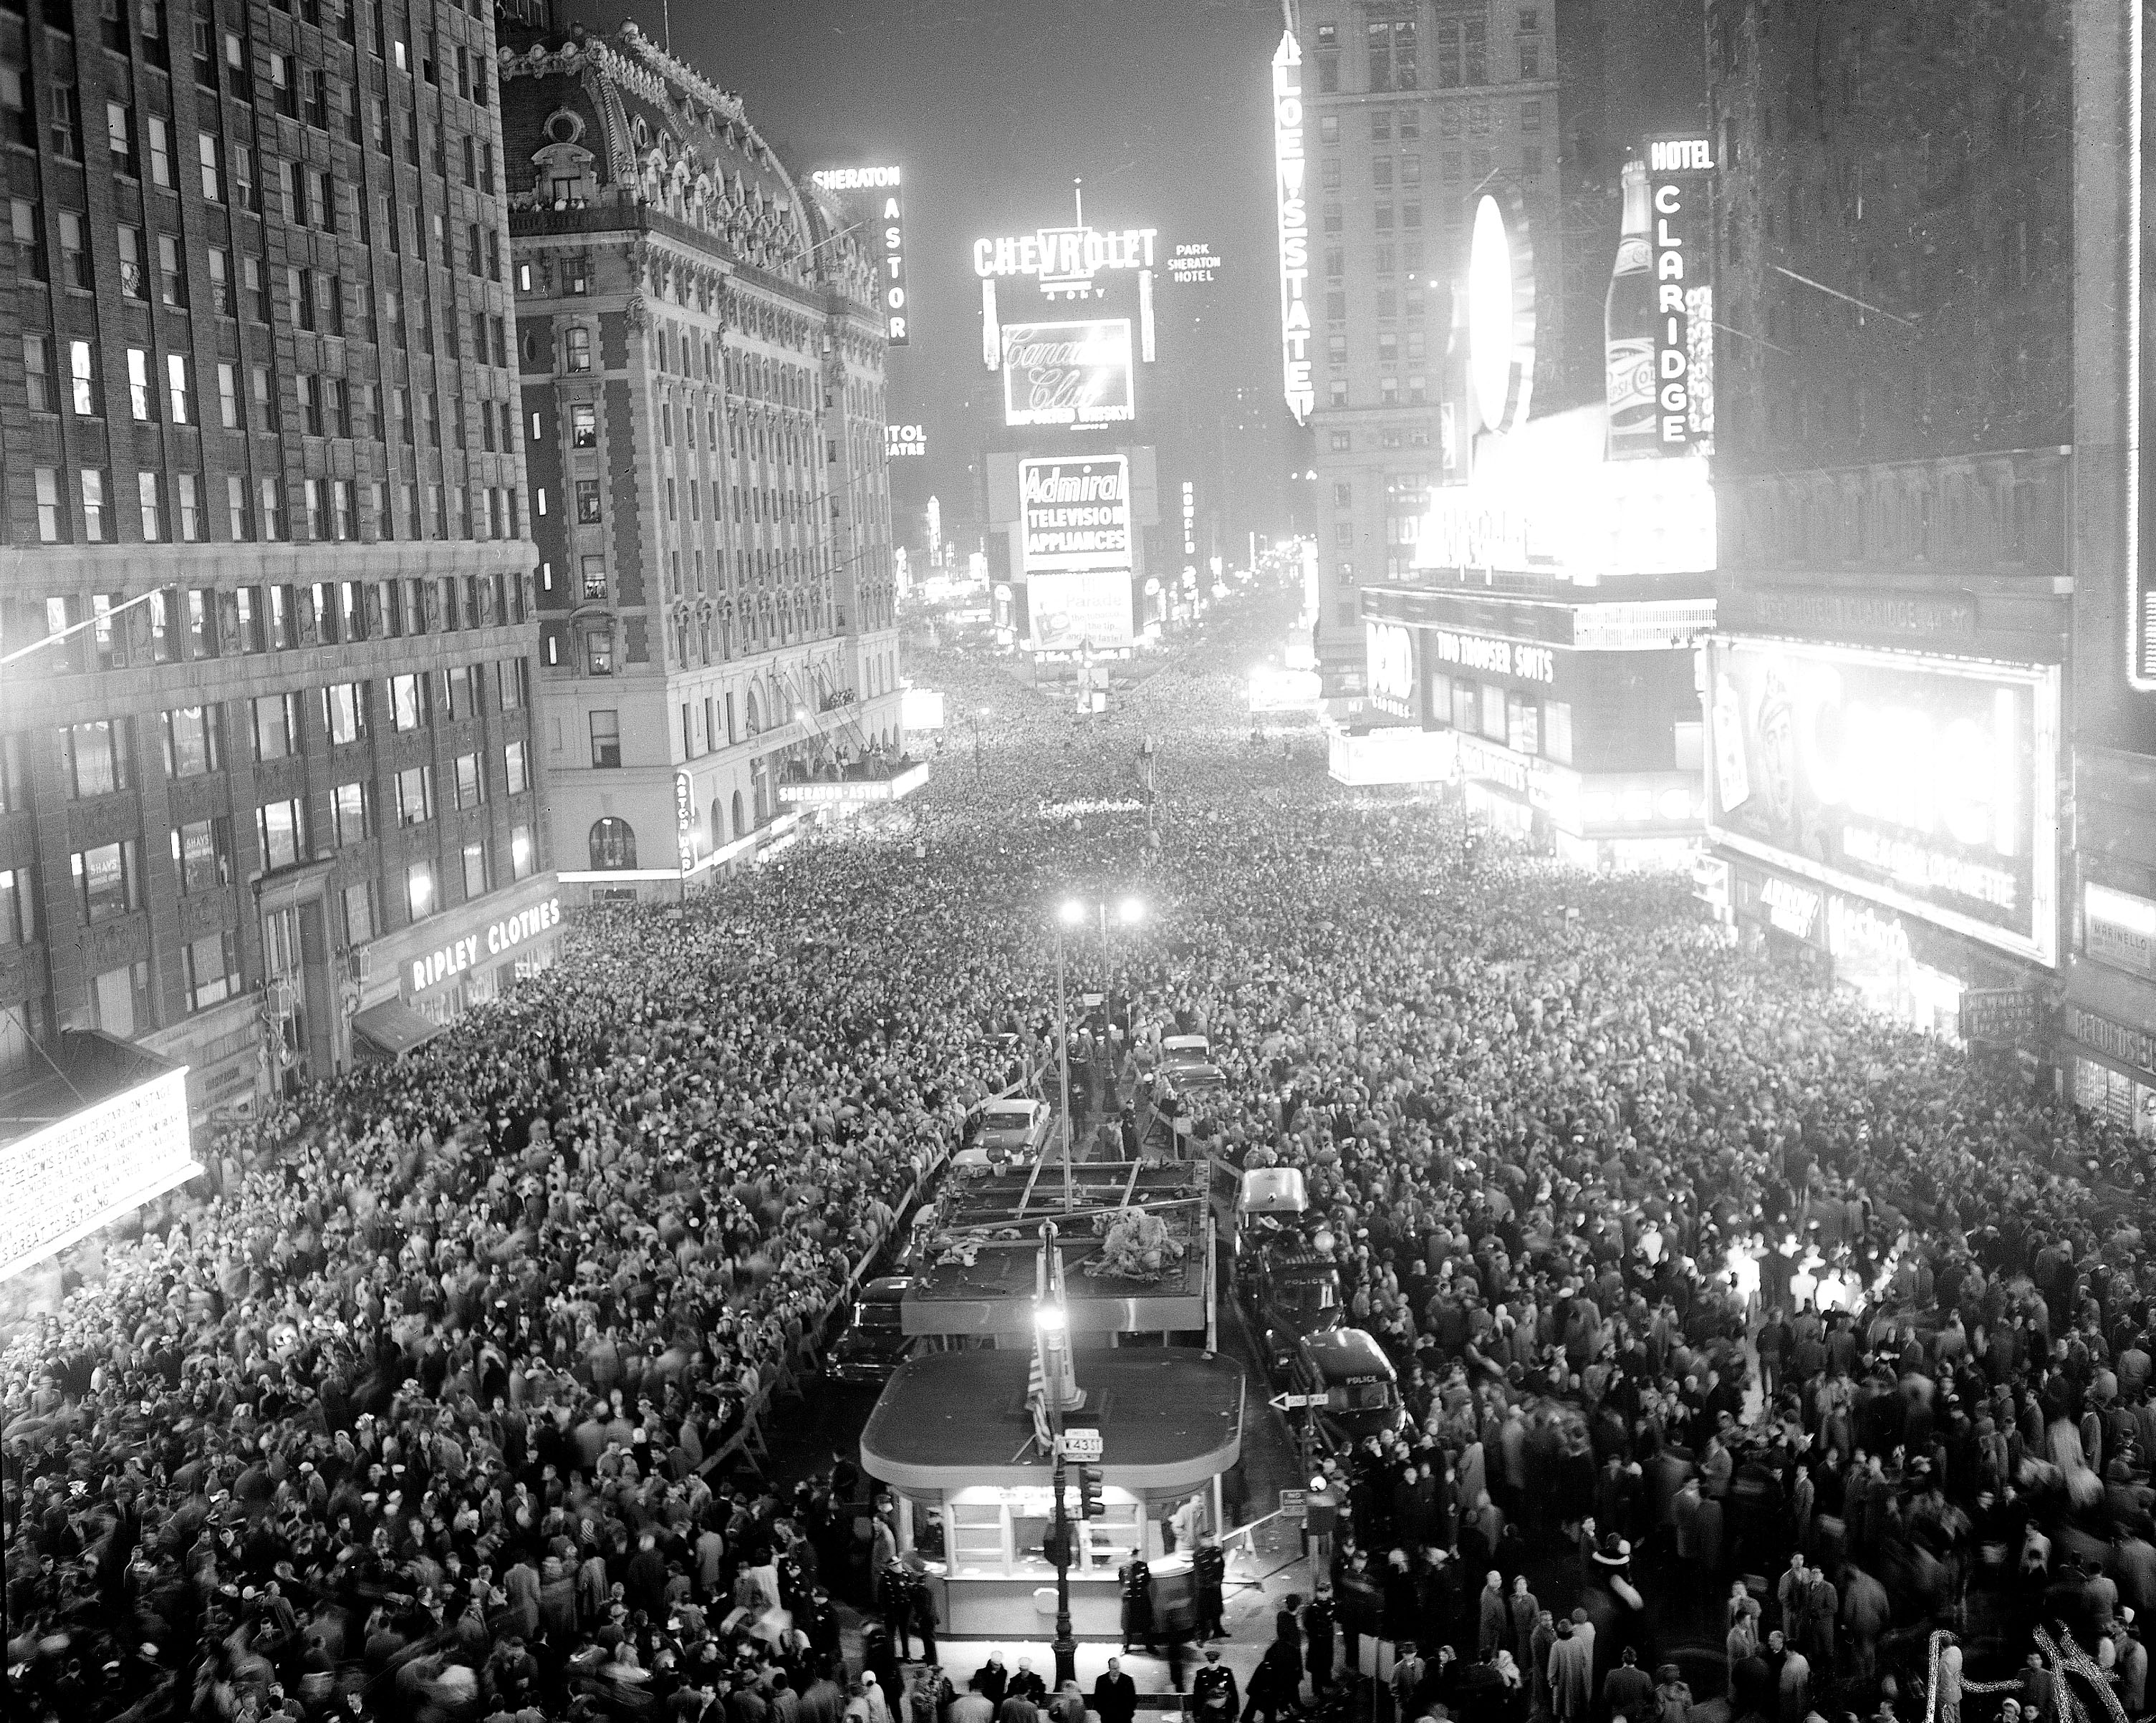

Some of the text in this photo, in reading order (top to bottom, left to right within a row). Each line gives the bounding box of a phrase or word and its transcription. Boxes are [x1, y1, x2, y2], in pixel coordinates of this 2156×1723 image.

[1651, 140, 1713, 170] HOTEL
[812, 166, 900, 190] SHERATON
[973, 228, 1158, 277] CHEVROLET
[1176, 243, 1210, 255] PARK
[883, 198, 905, 338] ASTOR
[1168, 256, 1221, 270] SHERATON
[1175, 270, 1214, 282] HOTEL
[1284, 236, 1312, 391] STATE
[1655, 185, 1686, 442] CLARIDGE
[1026, 463, 1127, 503] Admiral
[1028, 506, 1125, 529] TELEVISION
[1029, 532, 1126, 553] APPLIANCES
[1066, 593, 1122, 608] Parade
[1067, 633, 1082, 642] and
[1438, 632, 1553, 683] TWO TROUSER SUITS
[779, 784, 888, 801] SHERATON ASTOR
[90, 859, 117, 875] SHAYS
[413, 898, 560, 992] RIPLEY CLOTHES
[2093, 923, 2147, 951] MARINELLO
[129, 1098, 140, 1114] ON
[143, 1083, 171, 1106] STAGE
[57, 1138, 89, 1165] EVERLY
[93, 1126, 116, 1148] BROS
[11, 1225, 45, 1258] GREAT
[49, 1217, 60, 1236] TO
[65, 1209, 76, 1228] BE
[78, 1192, 108, 1220] YOUNG
[1285, 1277, 1327, 1286] POLICE
[1346, 1375, 1378, 1386] POLICE
[1074, 1439, 1089, 1451] 43
